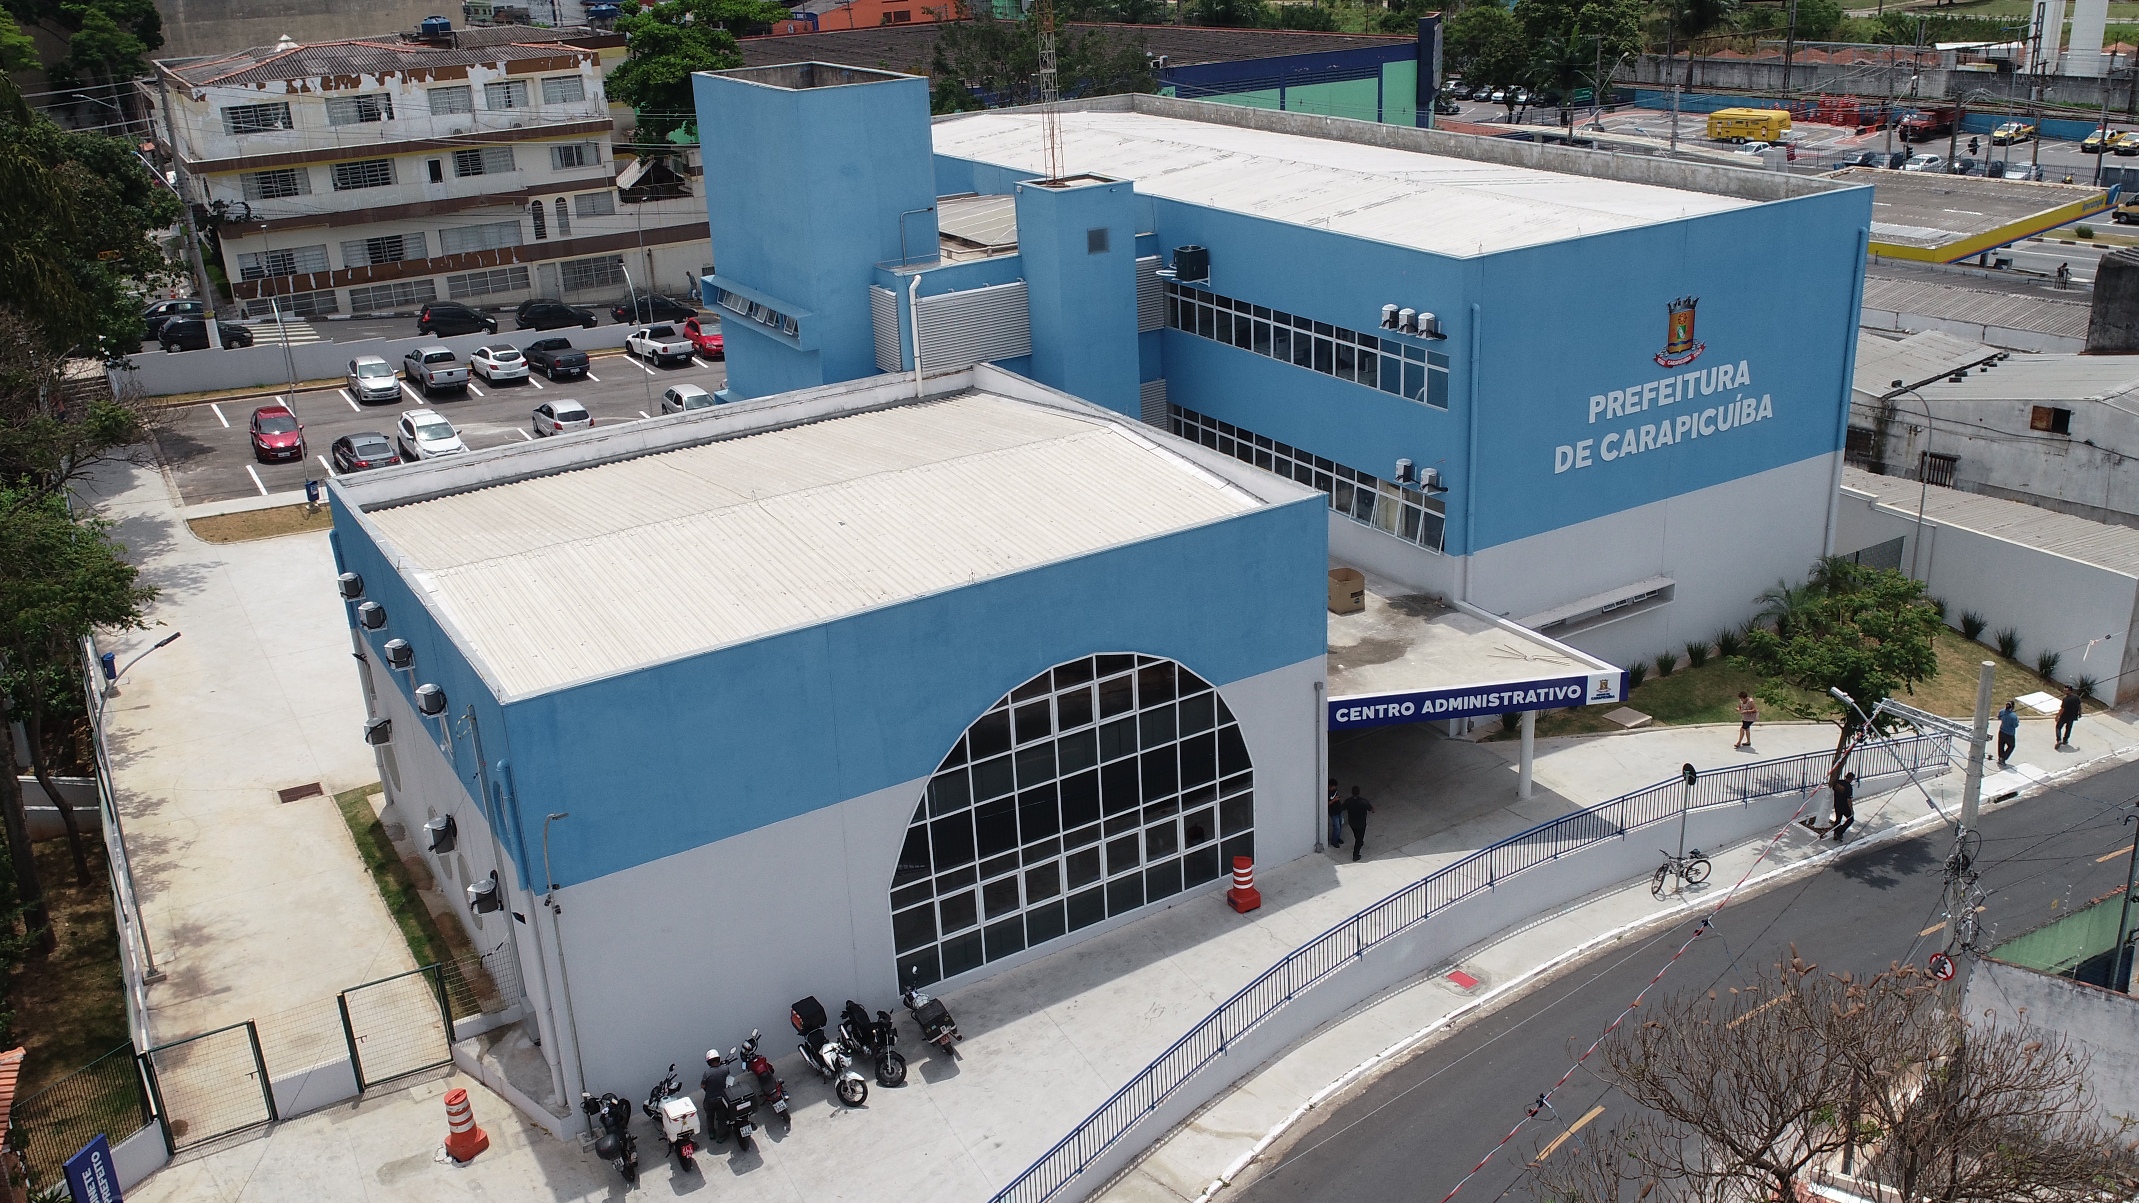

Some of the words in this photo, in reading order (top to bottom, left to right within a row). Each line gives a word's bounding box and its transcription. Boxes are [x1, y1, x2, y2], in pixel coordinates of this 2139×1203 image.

[1588, 360, 1750, 424] PREFEITURA
[1554, 439, 1593, 474] DE
[1600, 394, 1773, 462] CARAPICUÍBA
[1335, 702, 1415, 722] CENTRO
[1421, 685, 1582, 714] ADMINISTRATIVO
